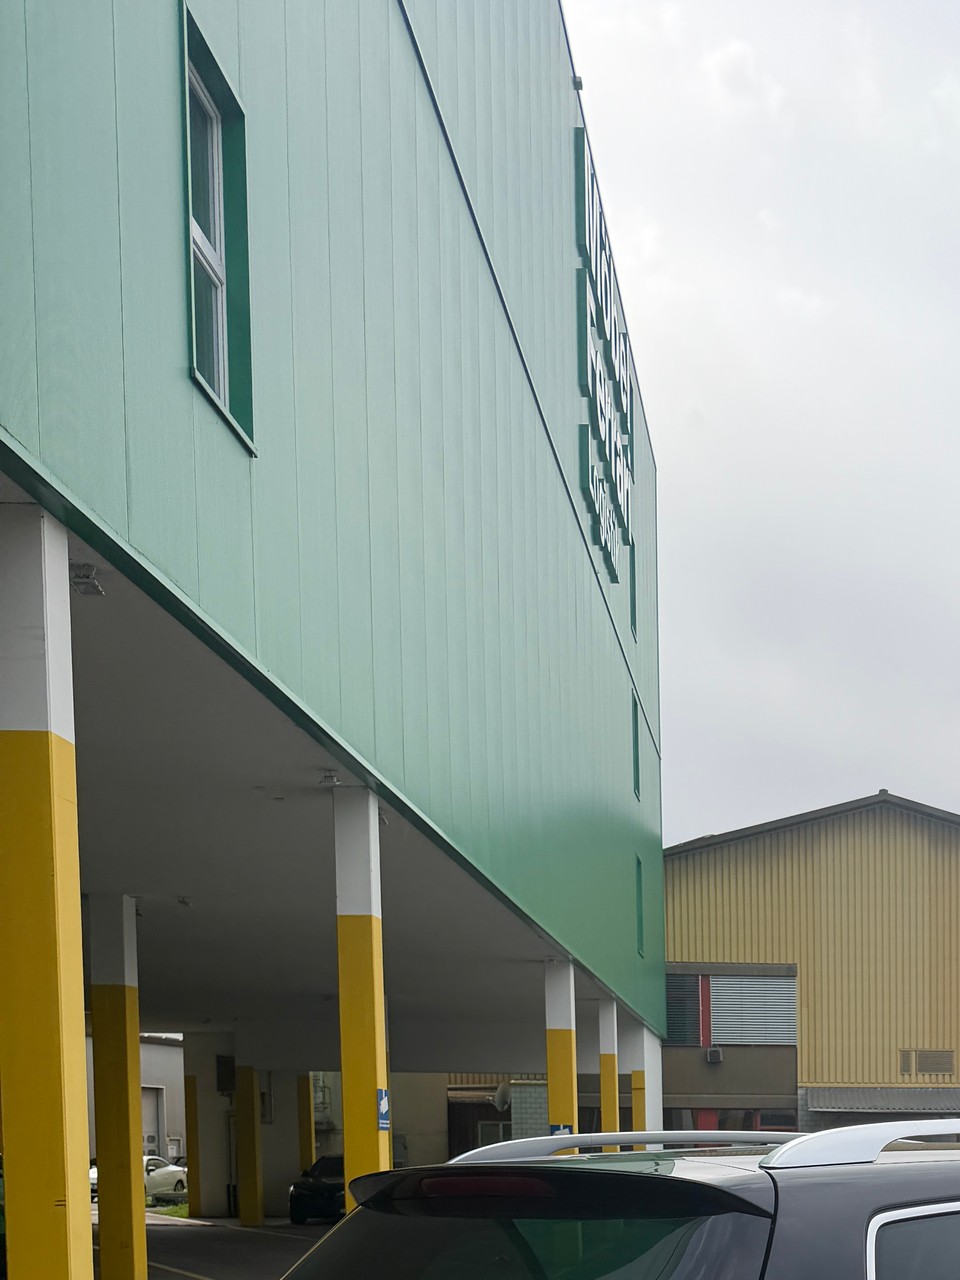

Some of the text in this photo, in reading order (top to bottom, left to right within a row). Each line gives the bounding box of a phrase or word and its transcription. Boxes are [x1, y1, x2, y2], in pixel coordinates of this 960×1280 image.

[584, 131, 630, 434] Möbel
[586, 269, 633, 545] Ferrari
[588, 424, 620, 583] Logistik
